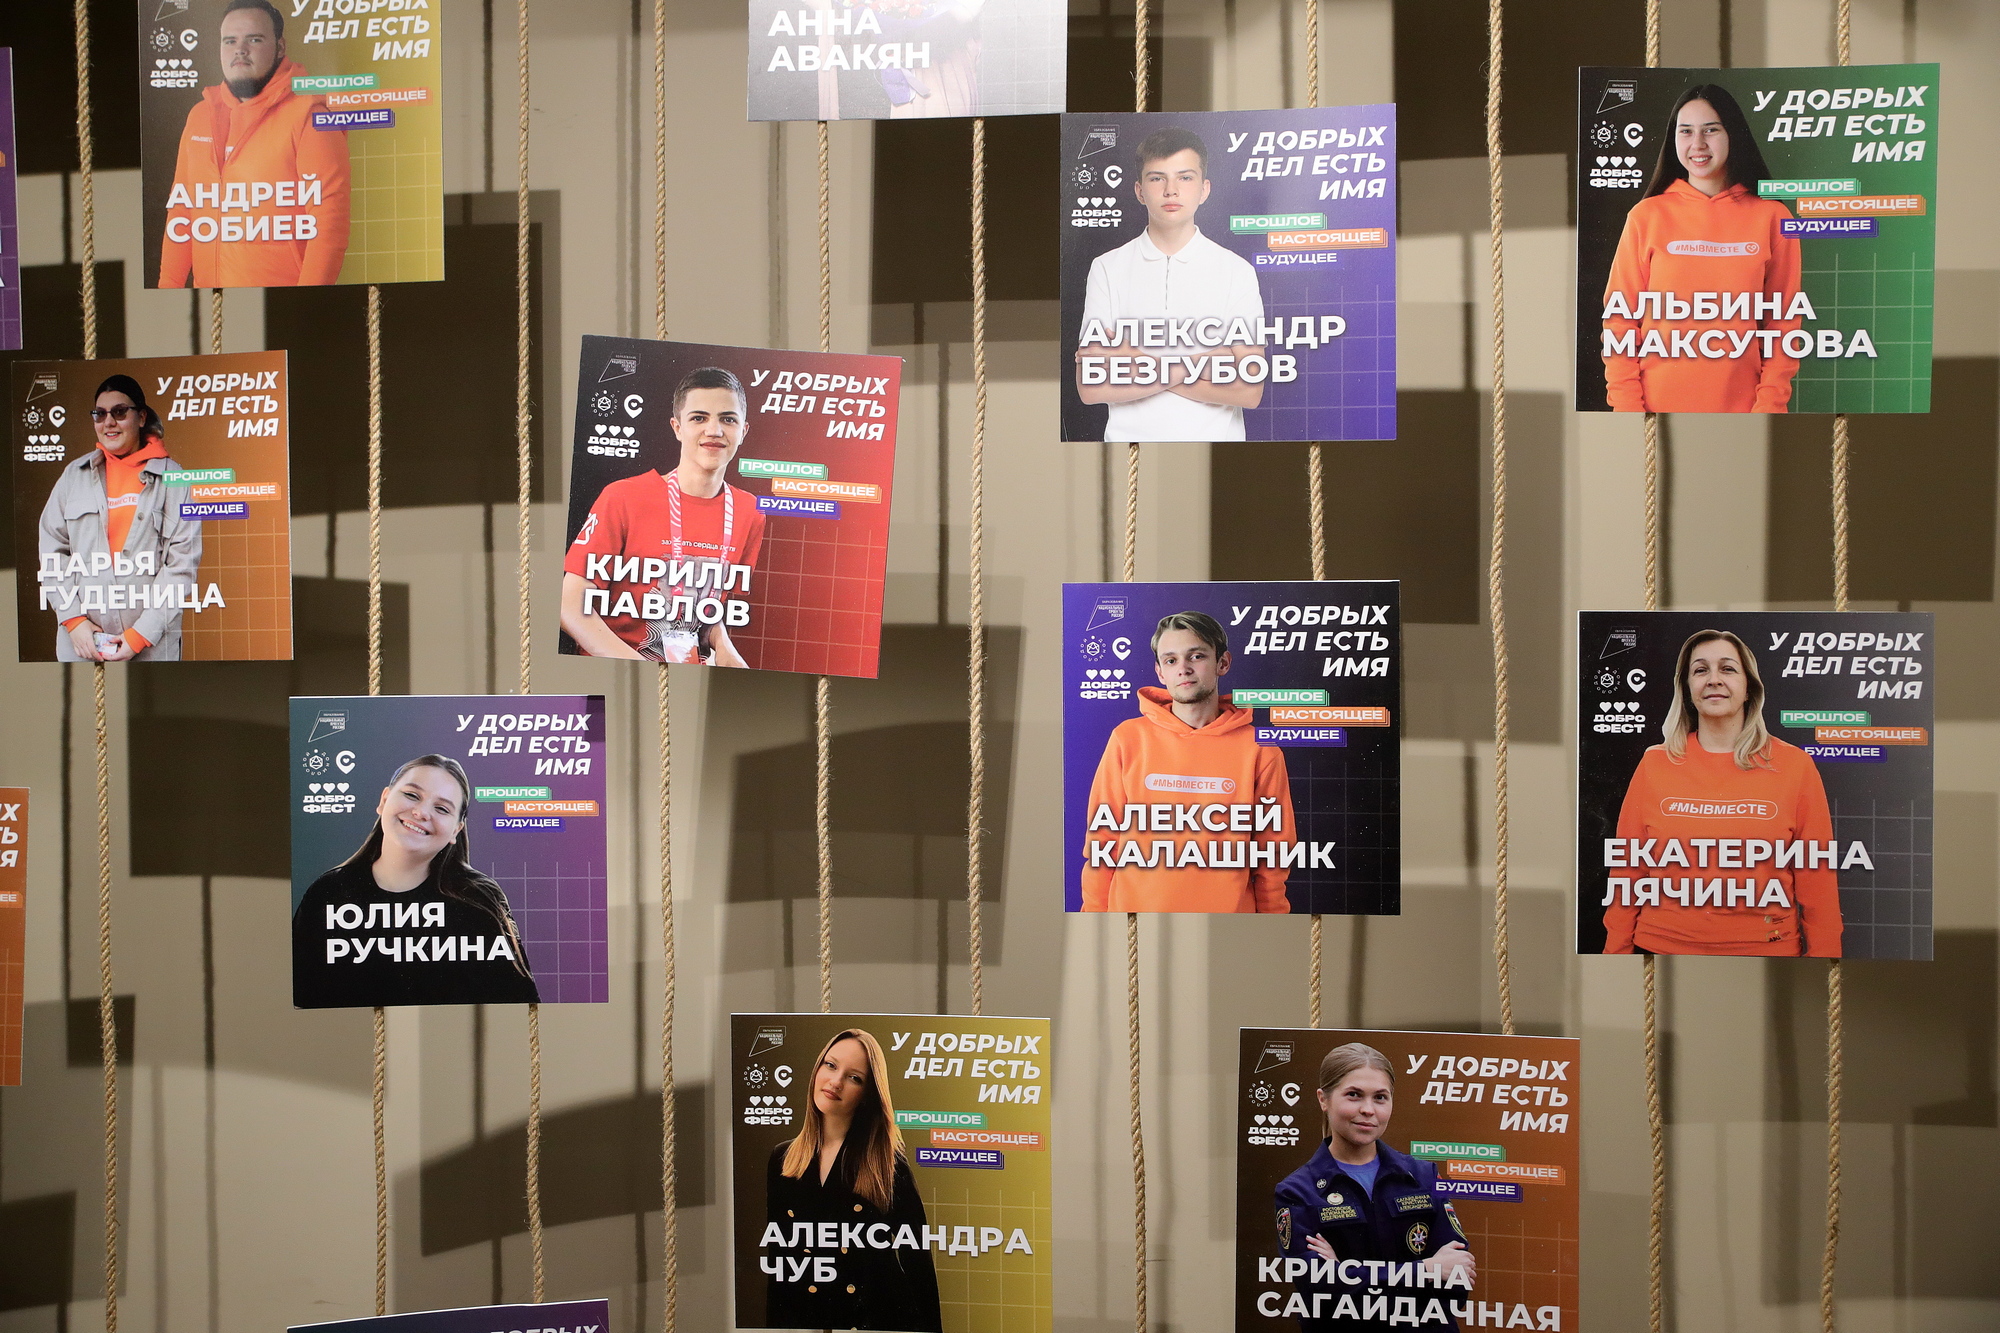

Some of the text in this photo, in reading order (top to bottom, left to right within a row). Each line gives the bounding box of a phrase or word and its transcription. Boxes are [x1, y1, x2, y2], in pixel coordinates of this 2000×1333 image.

[291, 0, 312, 16] У
[304, 15, 430, 44] ДЕЛ ЕСТЬ
[768, 9, 882, 36] АННА
[372, 39, 430, 61] ИМЯ
[768, 42, 930, 72] АВАКЯН
[150, 78, 198, 88] ФЕСТ
[293, 76, 374, 89] ПРОШЛОЕ
[328, 90, 426, 104] НАСТОЯЩЕЕ
[1753, 86, 1928, 114] У ДОБРЫХ
[316, 112, 388, 124] БУДУЩЕЕ
[1768, 114, 1925, 141] ДЕЛ ЕСТЬ
[1227, 126, 1387, 155] У ДОБРЫХ
[1852, 141, 1926, 163] ИМЯ
[1241, 153, 1385, 181] ДЕЛ ЕСТЬ
[1590, 169, 1642, 177] ДОБРО
[1319, 178, 1386, 200] ИМЯ
[1590, 178, 1642, 188] ФЕСТ
[1760, 181, 1854, 193] ПРОШЛОЕ
[166, 174, 321, 212] АНДРЕЙ
[1800, 198, 1917, 211] НАСТОЯЩЕЕ
[166, 214, 317, 242] СОБИЕВ
[1072, 218, 1122, 227] ФЕСТ
[1233, 216, 1321, 228] ПРОШЛОЕ
[1784, 220, 1870, 233] БУДУЩЕЕ
[1270, 232, 1380, 245] НАСТОЯЩЕЕ
[1675, 243, 1739, 254] #МЫВМЕСТЕ
[1256, 253, 1337, 265] БУДУЩЕЕ
[1602, 292, 1817, 321] АЛЬБИНА
[1080, 315, 1346, 350] АЛЕКСАНДР
[1603, 329, 1877, 359] МАКСУТОВА
[1081, 354, 1297, 385] БЕЗГУБОВ
[157, 371, 279, 396] У ДОБРЫХ
[750, 370, 889, 395] У ДОБРЫХ
[168, 395, 278, 420] ДЕЛ ЕСТЬ
[760, 393, 886, 418] ДЕЛ ЕСТЬ
[228, 418, 279, 438] ИМЯ
[826, 420, 884, 440] ИМЯ
[24, 445, 65, 453] ДОБРО
[587, 435, 640, 448] ДОБРО
[24, 453, 64, 461] ФЕСТ
[587, 446, 639, 458] ФЕСТ
[164, 471, 230, 481] ПРОШЛОЕ
[741, 461, 822, 475] ПРОШЛОЕ
[193, 485, 276, 496] НАСТОЯЩЕЕ
[774, 481, 875, 496] НАСТОЯЩЕЕ
[182, 504, 244, 514] БУДУЩЕЕ
[760, 498, 834, 512] БУДУЩЕЕ
[37, 551, 155, 582] ДАРЬЯ
[586, 553, 751, 592] КИРИЛЛ
[39, 583, 225, 614] ГУДЕНИЦА
[583, 589, 750, 627] ПАВЛОВ
[1230, 606, 1390, 629] У ДОБРЫХ
[1244, 632, 1389, 654] ДЕЛ ЕСТЬ
[1769, 632, 1924, 653] У ДОБРЫХ
[1322, 658, 1390, 676] ИМЯ
[1782, 657, 1922, 678] ДЕЛ ЕСТЬ
[1080, 682, 1130, 690] ДОБРО
[1857, 681, 1922, 699] ИМЯ
[1080, 691, 1130, 700] ФЕСТ
[1235, 692, 1323, 701] ПРОШЛОЕ
[1273, 710, 1383, 720] НАСТОЯЩЕЕ
[1783, 713, 1865, 722] ПРОШЛОЕ
[456, 714, 592, 734] У ДОБРЫХ
[1593, 723, 1645, 733] ФЕСТ
[1259, 730, 1340, 740] БУДУЩЕЕ
[1818, 730, 1920, 739] НАСТОЯЩЕЕ
[468, 736, 591, 756] ДЕЛ ЕСТЬ
[1805, 747, 1879, 756] БУДУЩЕЕ
[534, 759, 591, 775] ИМЯ
[1153, 779, 1216, 790] #МЫВМЕСТЕ
[303, 795, 355, 803] ДОБРО
[477, 789, 546, 797] ПРОШЛОЕ
[303, 804, 355, 813] ФЕСТ
[507, 803, 593, 812] НАСТОЯЩЕЕ
[1089, 797, 1282, 832] АЛЕКСЕЙ
[1669, 802, 1767, 816] #МЫВМЕСТЕ
[496, 819, 559, 827] БУДУЩЕЕ
[1091, 840, 1336, 869] КАЛАШНИК
[1604, 838, 1874, 870] ЕКАТЕРИНА
[1602, 877, 1790, 908] ЛЯЧИНА
[326, 902, 445, 930] ЮЛИЯ
[327, 936, 514, 964] РУЧКИНА
[891, 1032, 1042, 1055] У ДОБРЫХ
[904, 1058, 1041, 1079] ДЕЛ ЕСТЬ
[1406, 1055, 1570, 1081] У ДОБРЫХ
[978, 1084, 1041, 1104] ИМЯ
[1420, 1082, 1569, 1106] ДЕЛ ЕСТЬ
[744, 1116, 792, 1125] ФЕСТ
[896, 1113, 981, 1125] ПРОШЛОЕ
[1500, 1111, 1569, 1134] ИМЯ
[933, 1132, 1038, 1144] НАСТОЯЩЕЕ
[1248, 1127, 1299, 1135] ДОБРО
[1248, 1136, 1299, 1145] ФЕСТ
[920, 1150, 997, 1163] БУДУЩЕЕ
[1413, 1144, 1499, 1157] ПРОШЛОЕ
[1450, 1164, 1558, 1178] НАСТОЯЩЕЕ
[1436, 1182, 1515, 1195] БУДУЩЕЕ
[760, 1222, 1033, 1257] АЛЕКСАНДРА
[760, 1256, 838, 1282] ЧУБ
[1258, 1257, 1473, 1291] КРИСТИНА
[1257, 1289, 1561, 1333] САГАЙДАЧНАЯ
